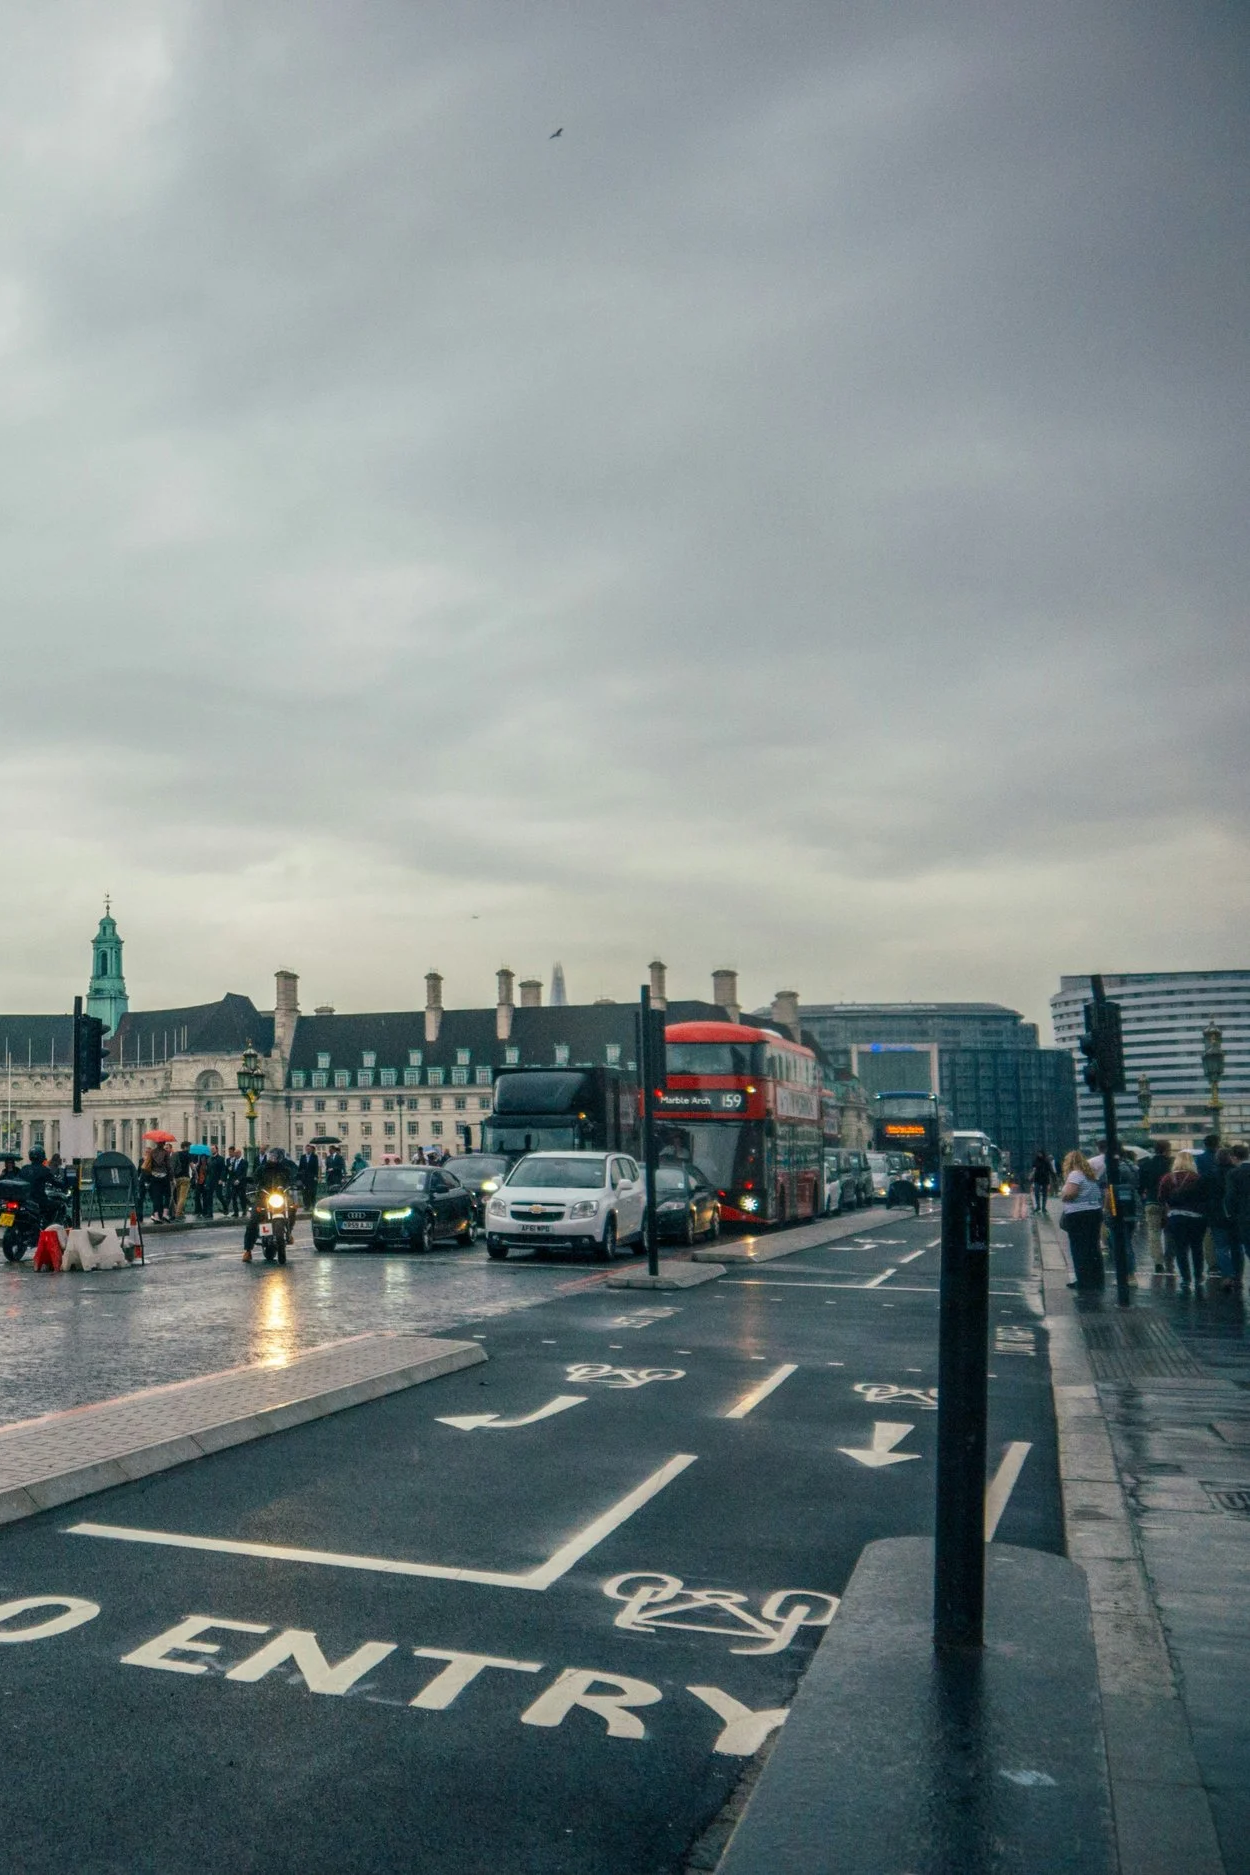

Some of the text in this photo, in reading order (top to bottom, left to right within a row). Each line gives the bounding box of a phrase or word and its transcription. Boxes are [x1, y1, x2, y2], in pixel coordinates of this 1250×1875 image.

[660, 1094, 742, 1107] Marble Arch 159
[120, 1614, 788, 1756] ENTRY
